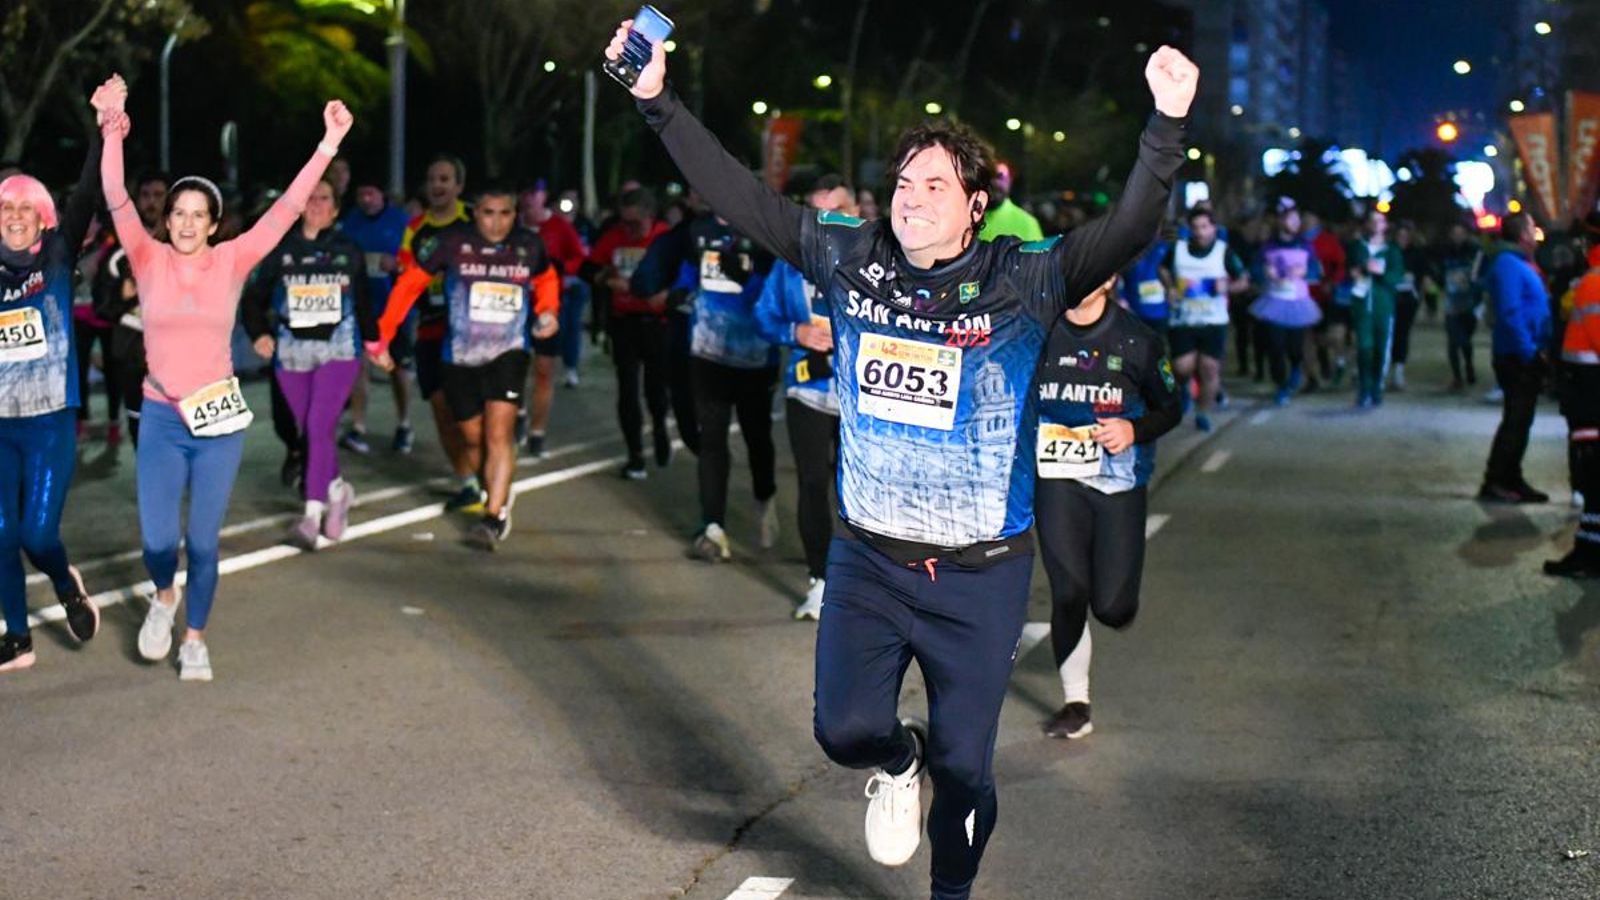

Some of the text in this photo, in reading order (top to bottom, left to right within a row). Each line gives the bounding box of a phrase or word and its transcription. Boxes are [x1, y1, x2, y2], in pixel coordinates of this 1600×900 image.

[461, 263, 487, 276] SAN
[846, 290, 891, 325] SAN
[863, 358, 948, 397] 6053
[1061, 381, 1123, 405] ANTÓN
[193, 392, 243, 421] 4549
[1044, 440, 1099, 458] 4741
